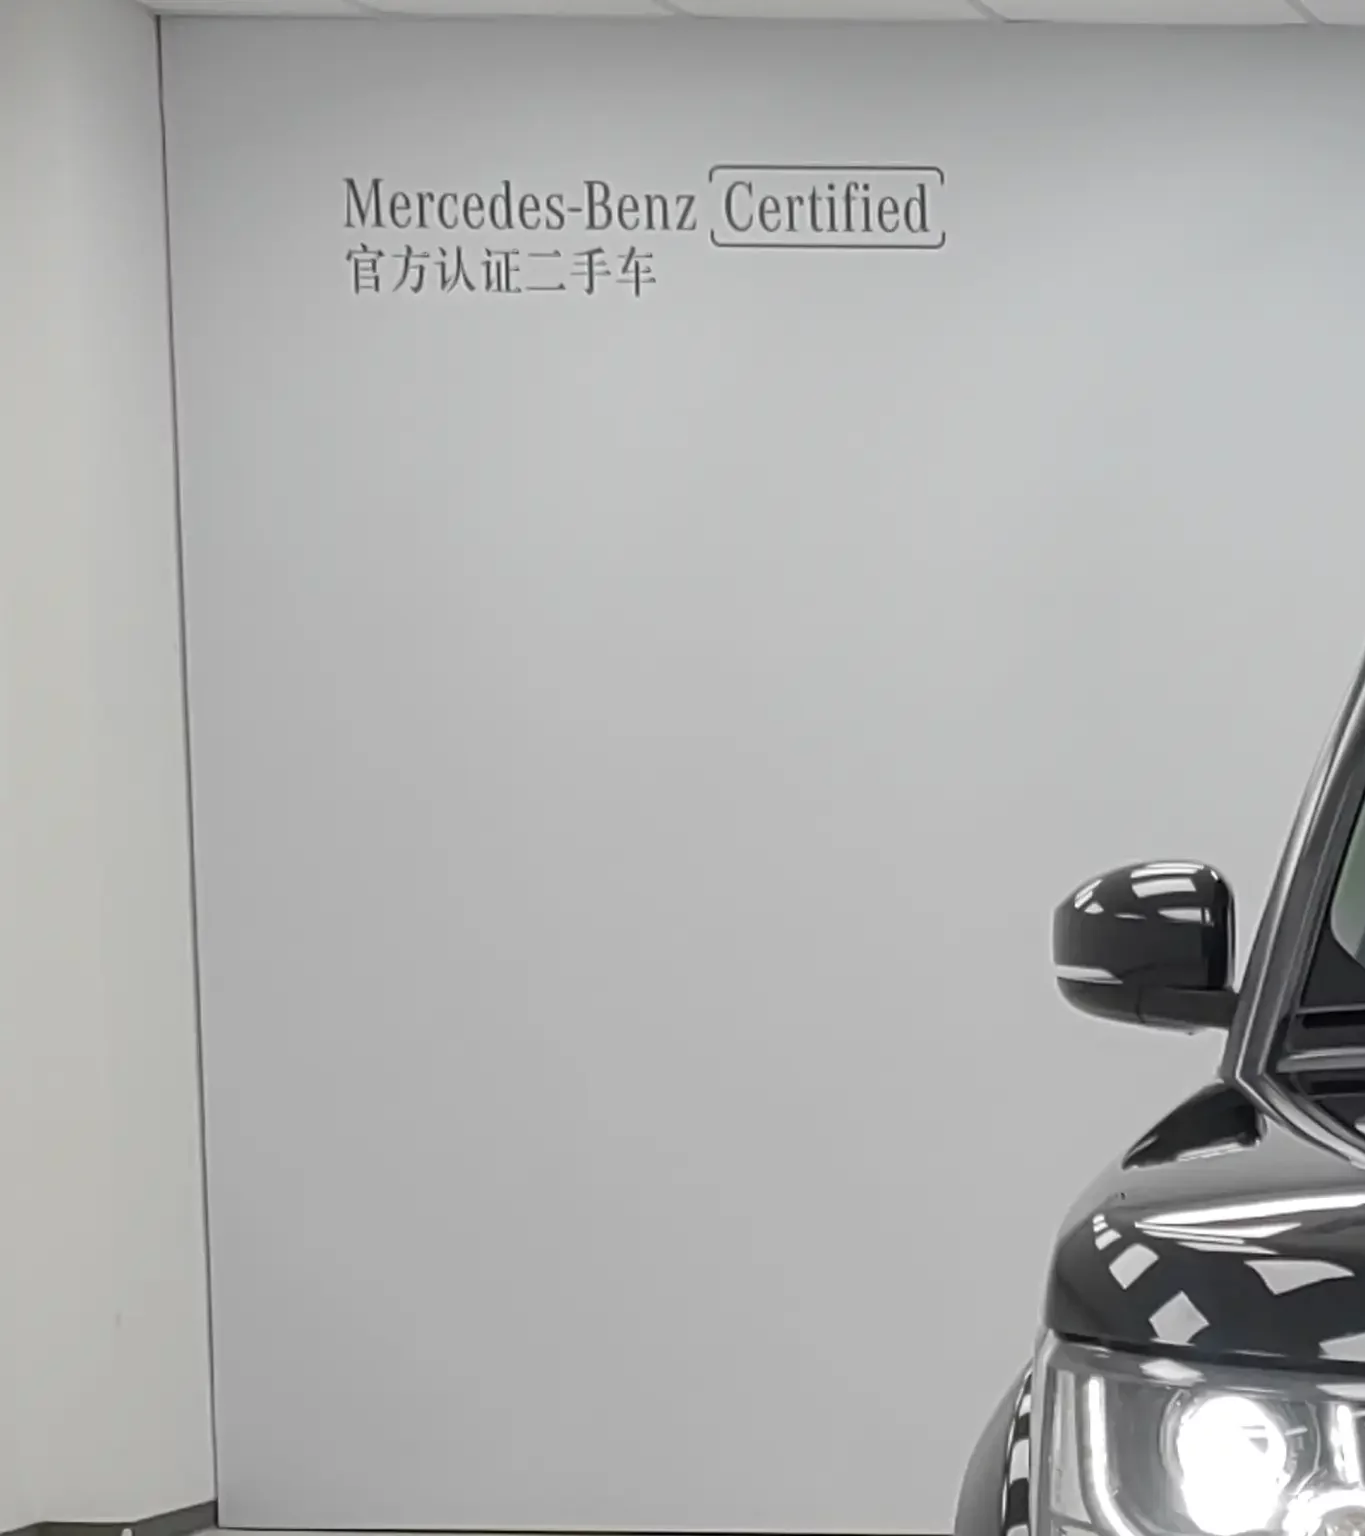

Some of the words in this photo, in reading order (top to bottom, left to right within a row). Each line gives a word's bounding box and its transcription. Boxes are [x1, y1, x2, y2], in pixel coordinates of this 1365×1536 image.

[342, 177, 698, 231] Mercedes-Benz
[724, 180, 931, 234] Certified
[345, 243, 658, 297] 官方认证二手车
